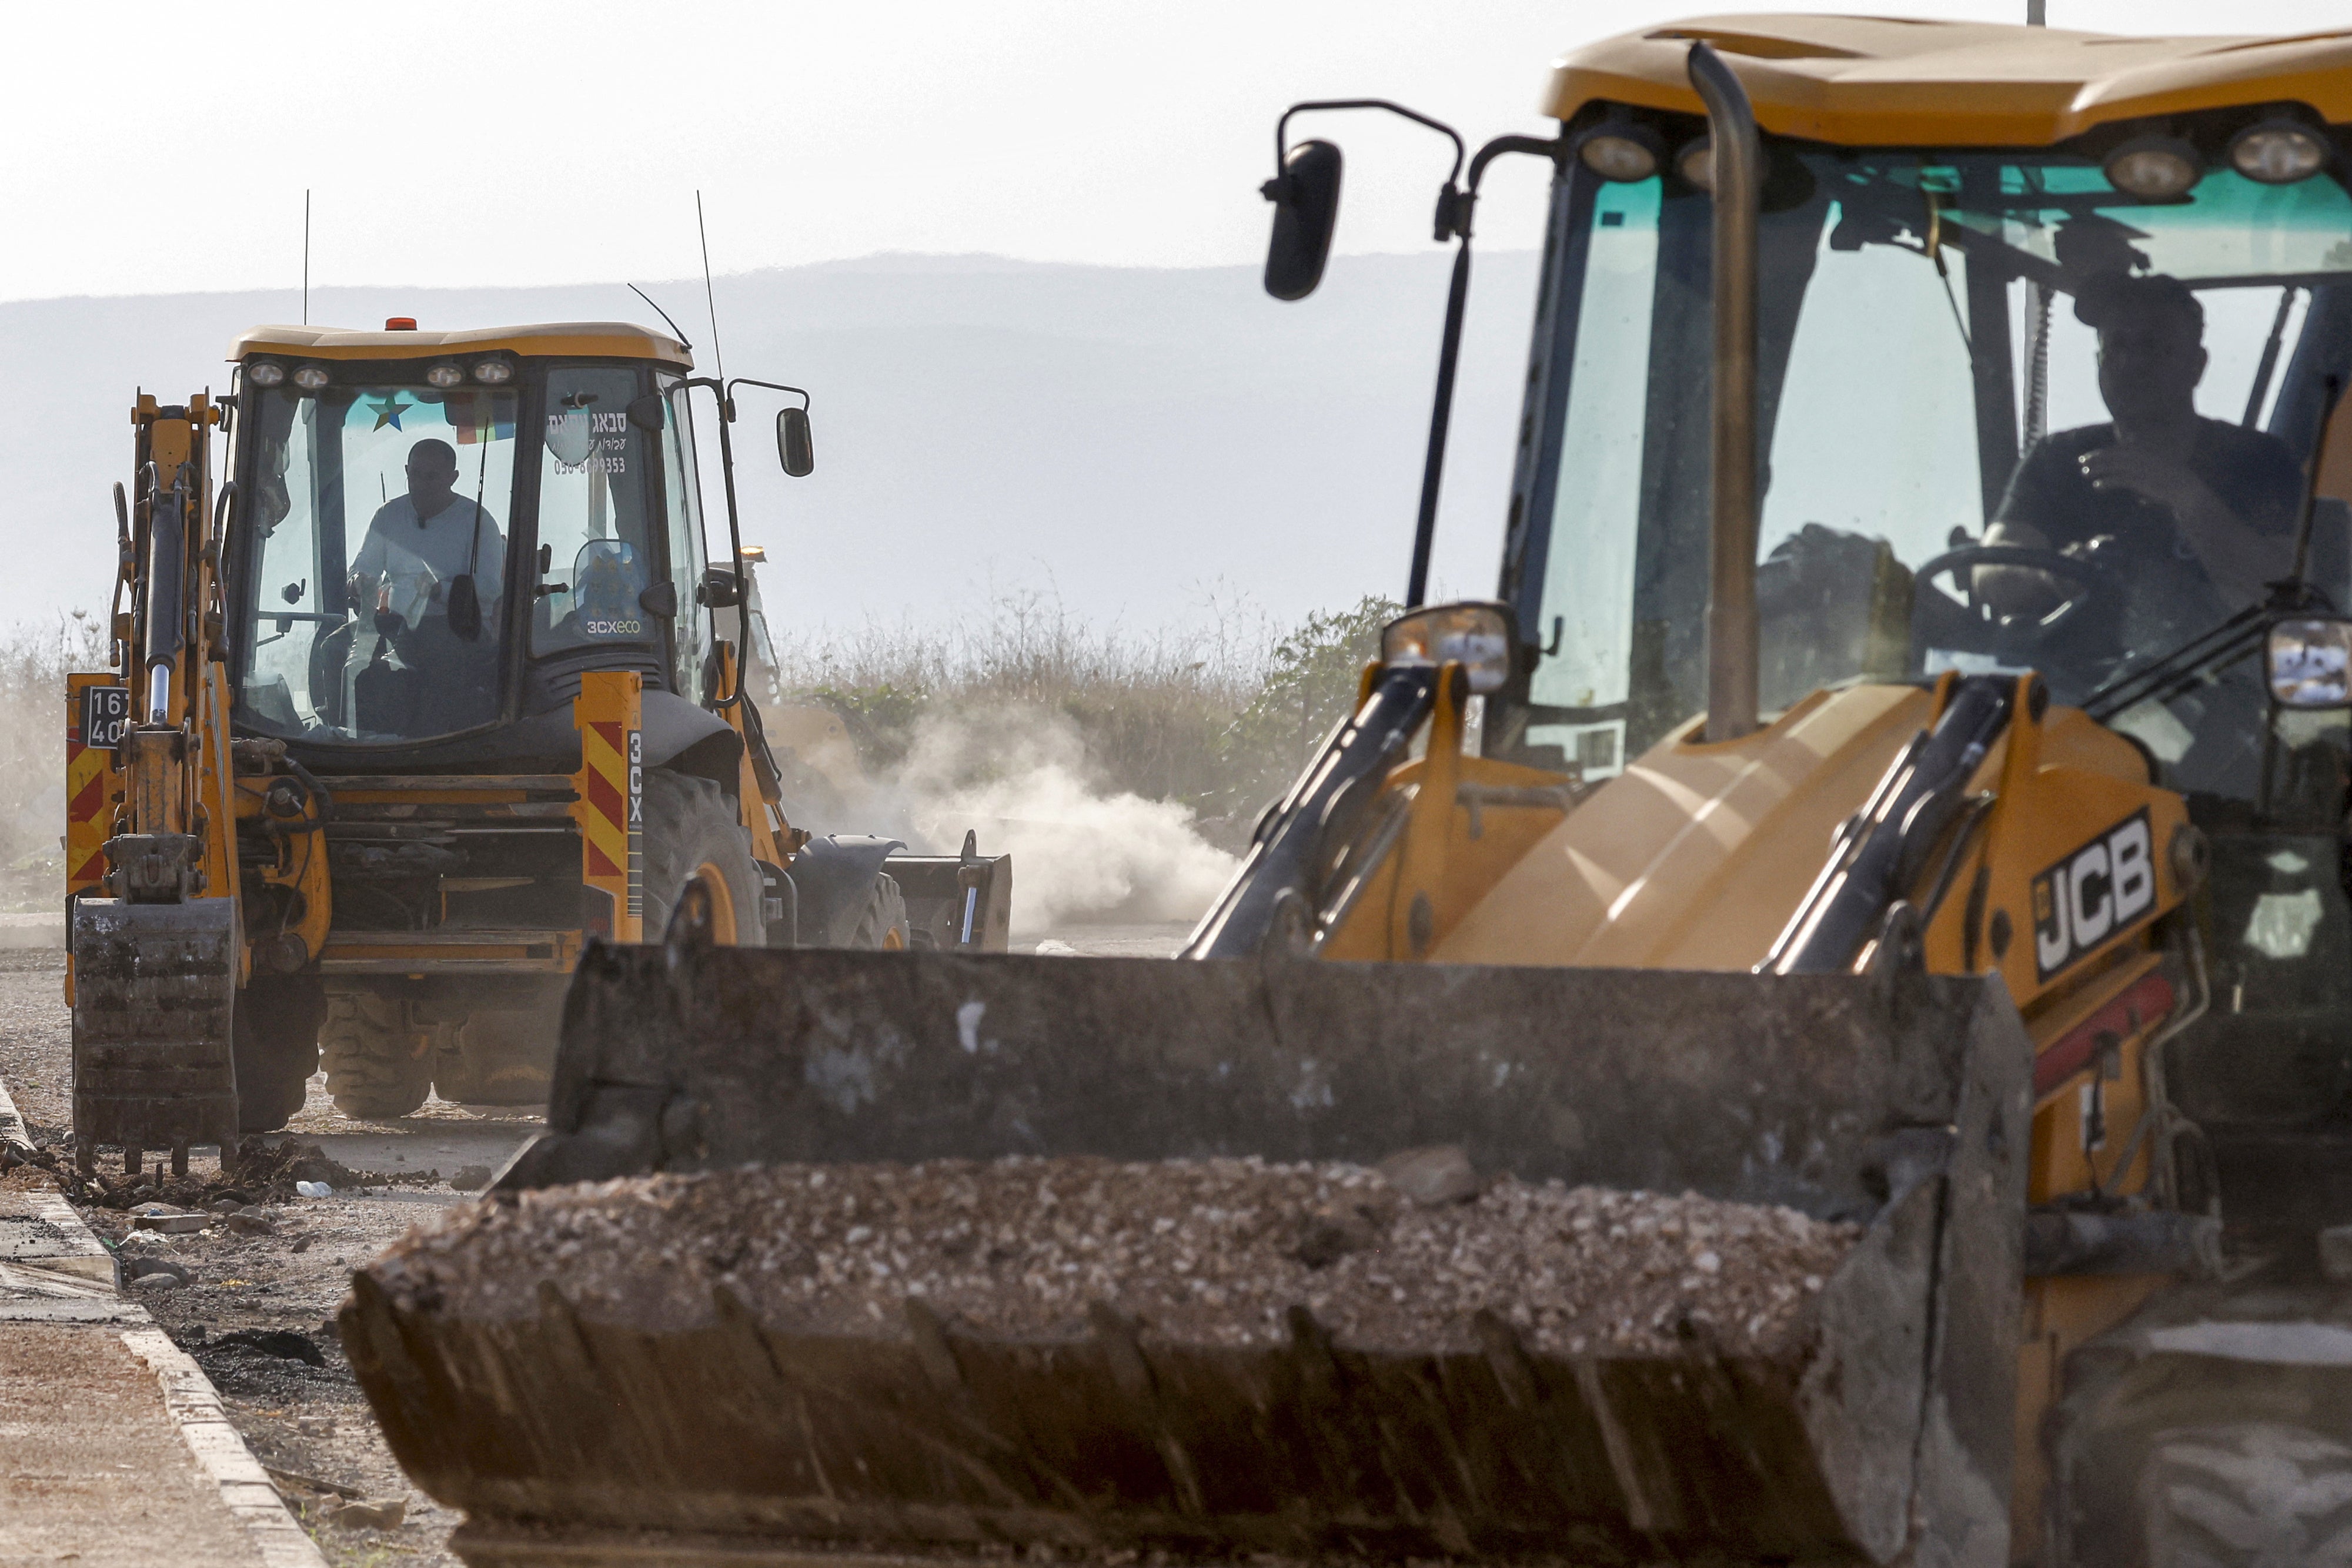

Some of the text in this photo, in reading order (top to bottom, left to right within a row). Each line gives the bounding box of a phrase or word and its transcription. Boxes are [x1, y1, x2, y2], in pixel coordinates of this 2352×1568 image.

[592, 413, 627, 433] סבאג
[596, 437, 626, 453] עבודות
[93, 692, 129, 716] 16
[630, 733, 642, 822] 3CX
[2037, 818, 2154, 972] JCB
